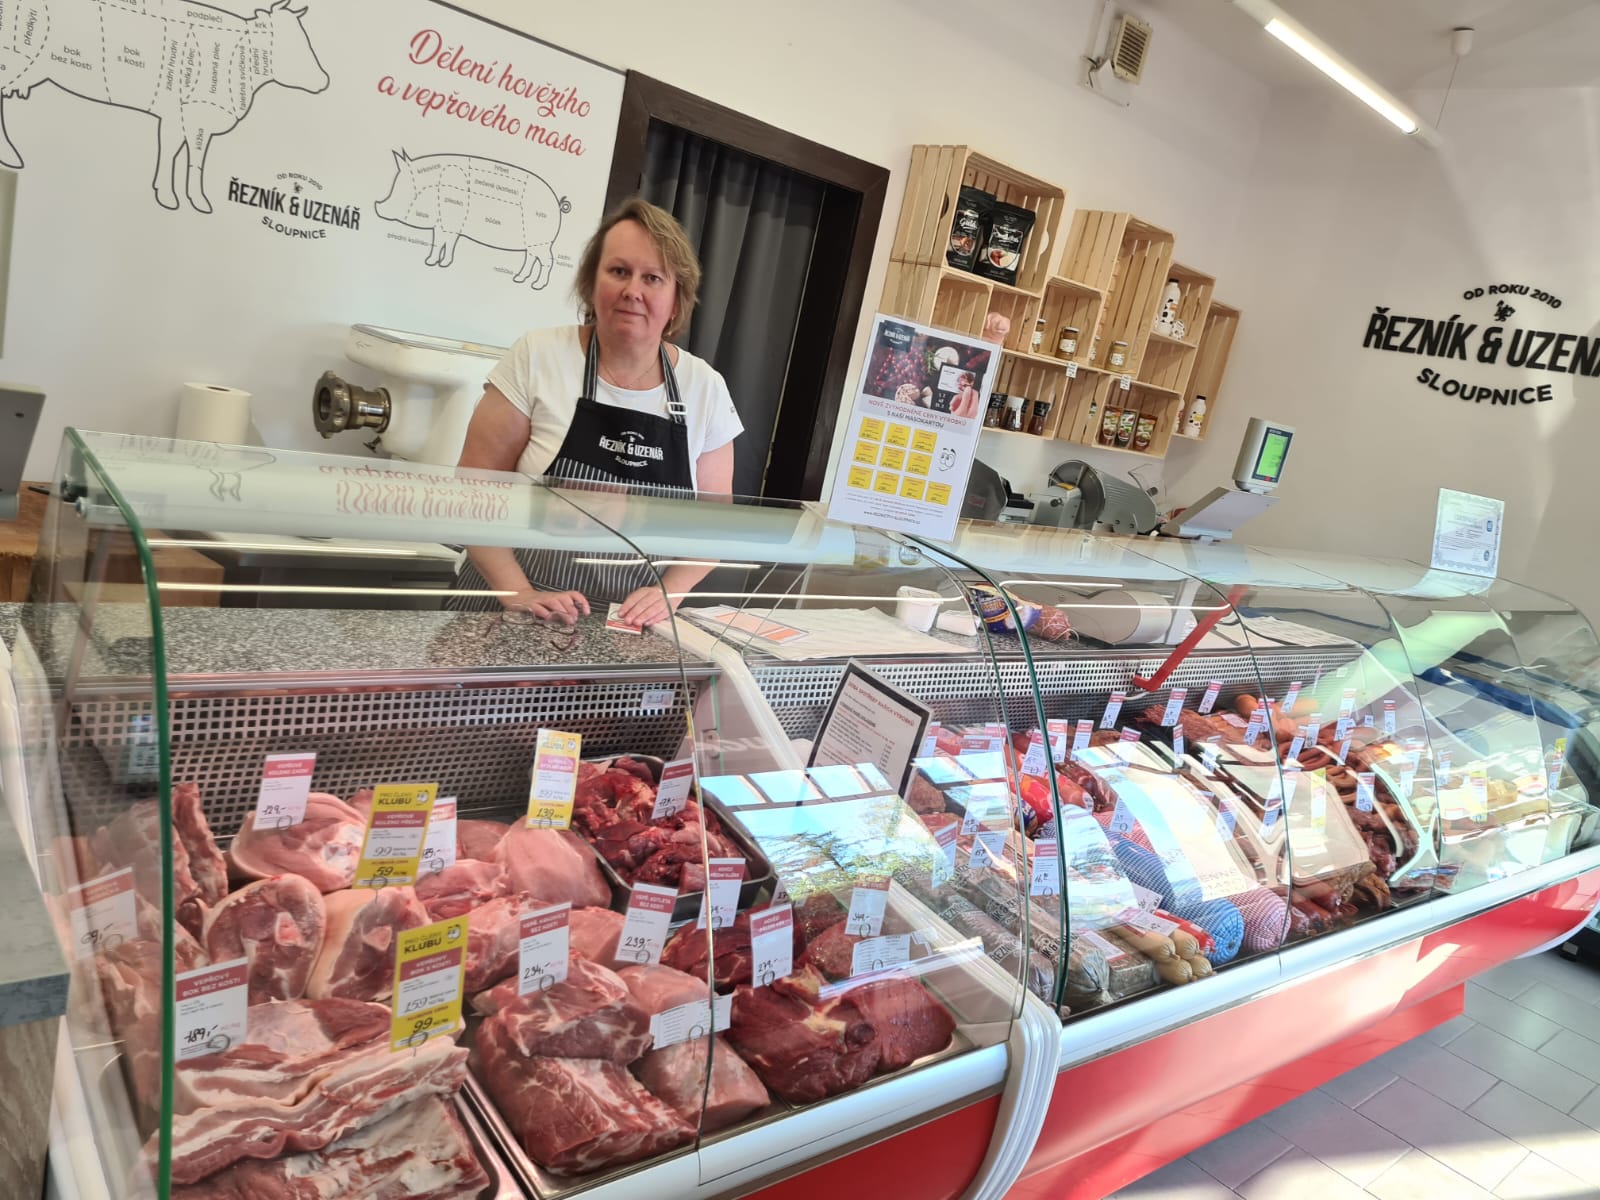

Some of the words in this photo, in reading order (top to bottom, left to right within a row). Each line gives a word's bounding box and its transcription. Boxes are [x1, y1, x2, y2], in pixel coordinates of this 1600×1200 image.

[254, 21, 267, 29] krk
[63, 45, 80, 57] bok
[123, 45, 140, 57] bok
[168, 40, 178, 68] hrudní
[188, 48, 196, 66] plec
[212, 42, 221, 60] plec
[51, 52, 67, 64] bez
[70, 58, 92, 71] kosti
[408, 29, 496, 85] Dělení
[498, 64, 592, 119] hovězího
[377, 75, 401, 97] a
[401, 82, 521, 136] vepřového
[524, 123, 588, 157] masa
[288, 172, 308, 181] ROKU
[228, 177, 287, 214] ŘEZNÍK
[289, 196, 301, 216] &
[302, 199, 360, 231] UZENÁŘ
[261, 216, 327, 239] SLOUPNICE
[1463, 287, 1484, 300] OD
[1489, 284, 1530, 296] ROKU
[1529, 288, 1563, 309] 2010
[1362, 306, 1478, 361] ŘEZNÍK
[1477, 326, 1504, 364] &
[1416, 367, 1554, 406] SLOUPNICE
[627, 443, 635, 455] &
[378, 797, 412, 806] KLUBU
[376, 866, 394, 877] 59
[404, 937, 442, 955] KLUBU
[182, 988, 200, 997] BOK
[413, 1017, 433, 1034] 99
